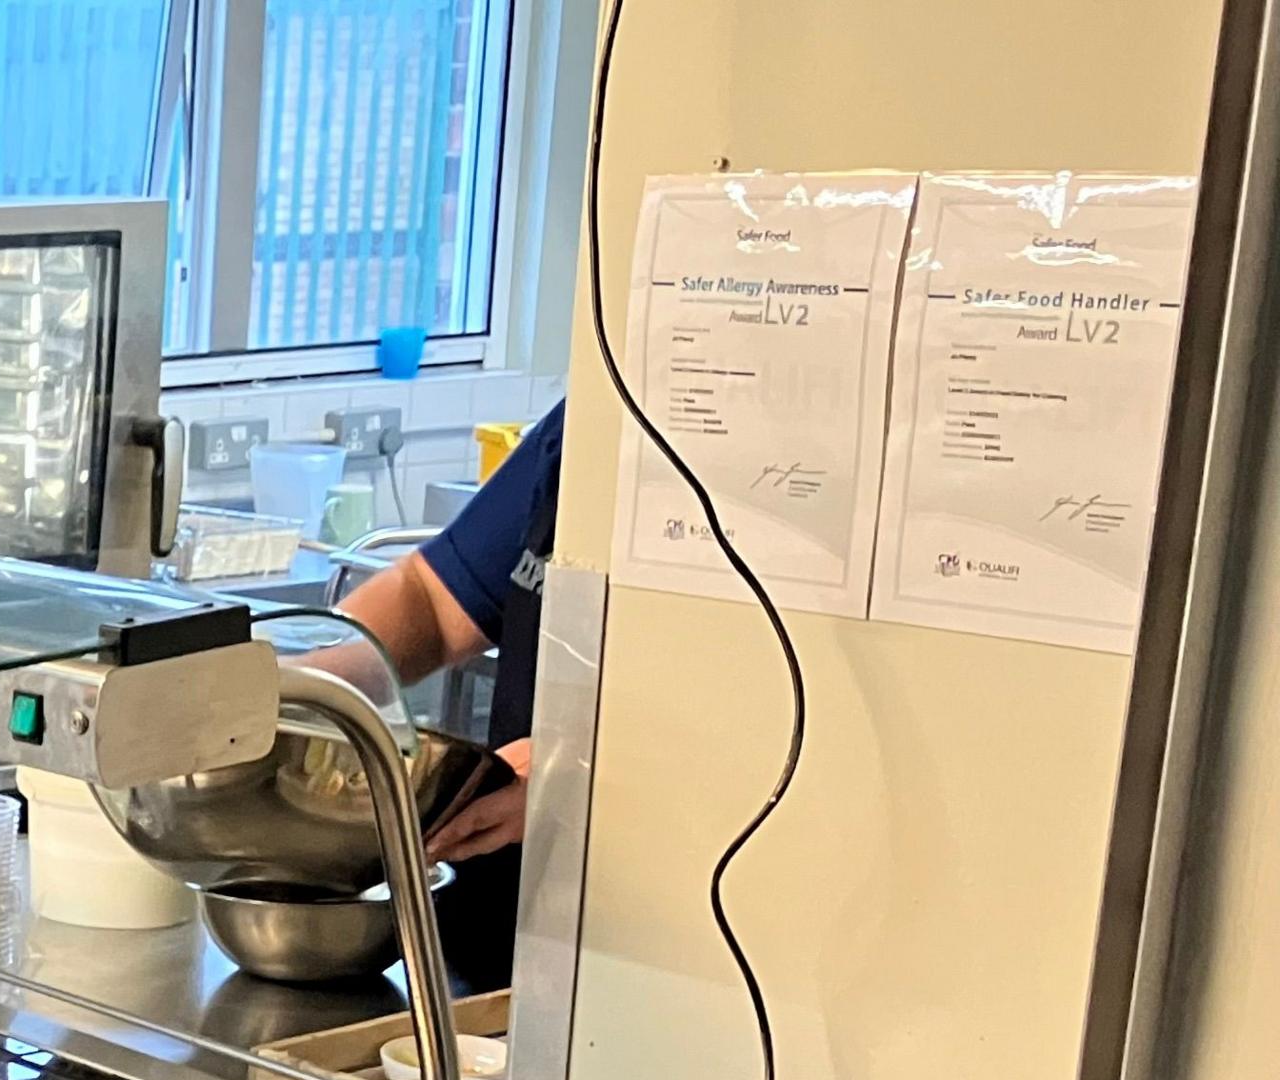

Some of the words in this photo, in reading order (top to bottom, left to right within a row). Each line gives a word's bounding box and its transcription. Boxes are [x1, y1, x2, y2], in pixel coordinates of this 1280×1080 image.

[737, 229, 763, 242] Safer
[765, 229, 791, 241] Food
[681, 277, 714, 292] Safer
[717, 277, 763, 296] Allergy
[766, 279, 839, 295] Awareness
[729, 310, 762, 323] Award
[764, 295, 809, 326] LV2
[962, 289, 1010, 305] Safer
[1018, 290, 1063, 307] Food
[1071, 293, 1149, 311] Handler
[1017, 326, 1057, 341] Award
[1066, 311, 1120, 344] LV2
